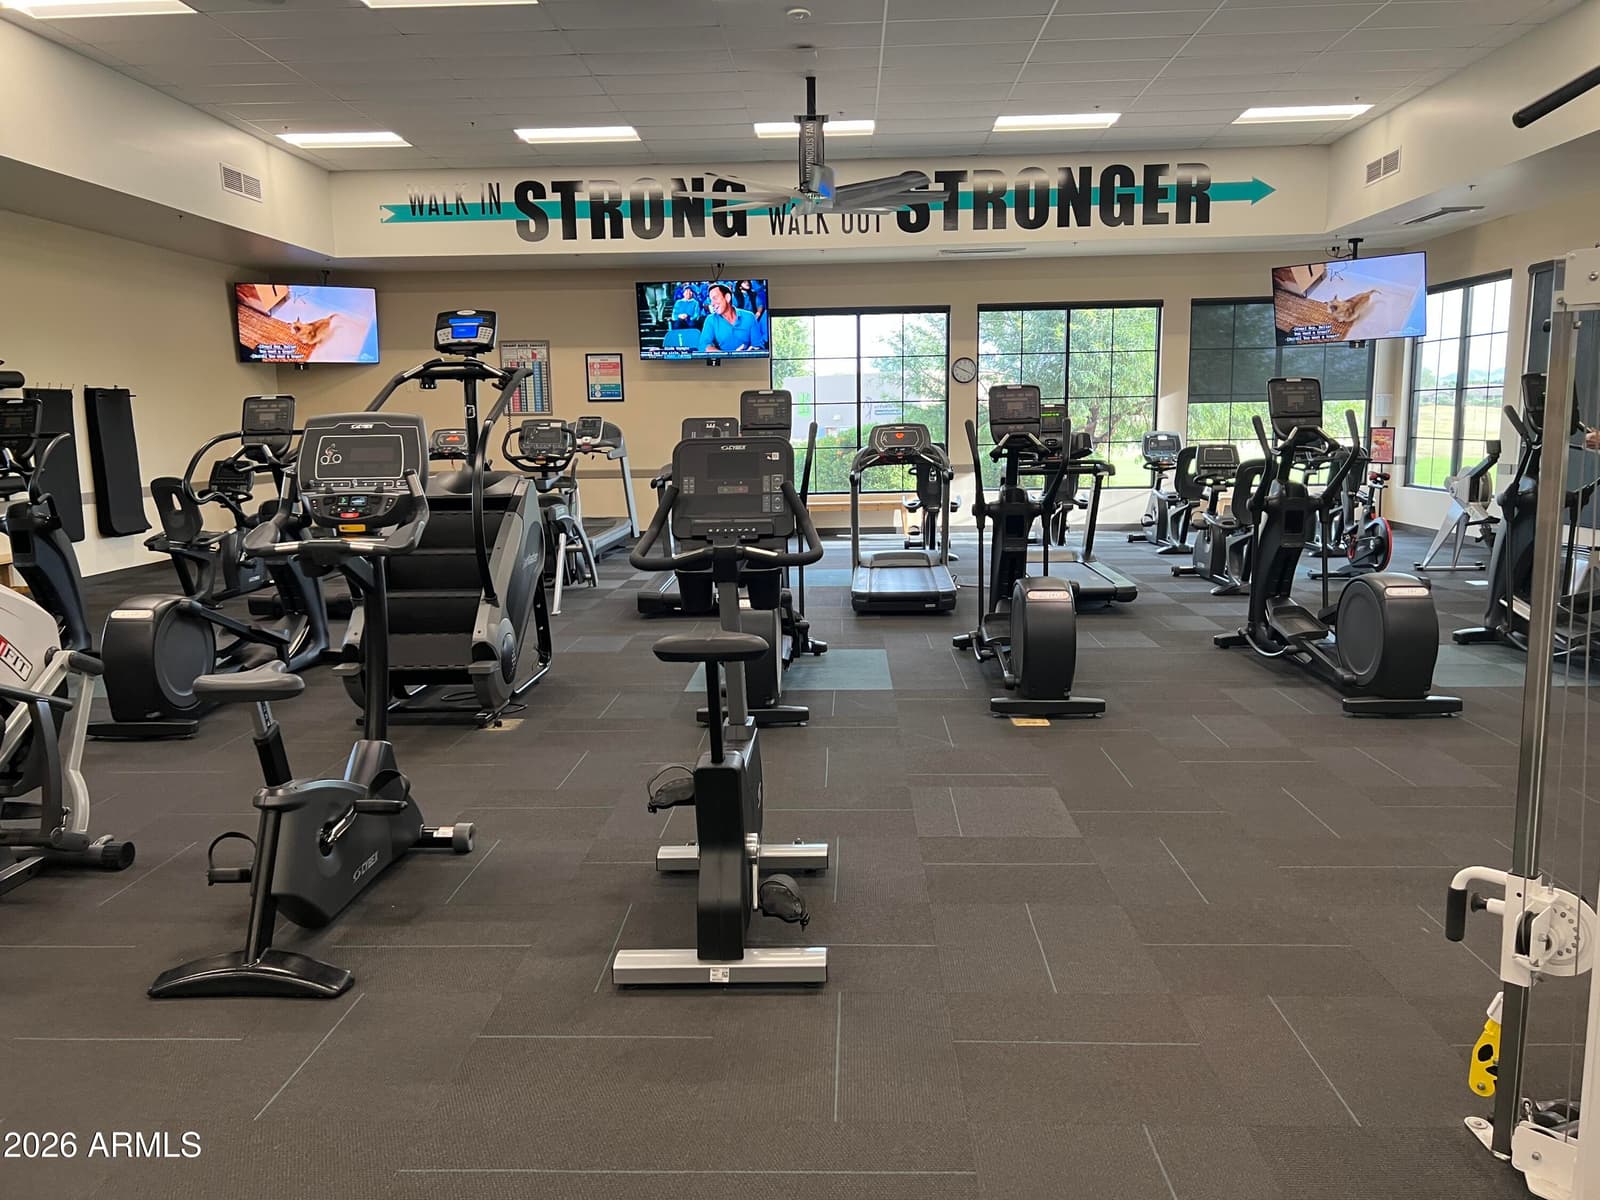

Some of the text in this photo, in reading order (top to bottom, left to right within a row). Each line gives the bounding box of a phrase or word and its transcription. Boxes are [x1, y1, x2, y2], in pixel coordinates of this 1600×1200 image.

[406, 182, 468, 216] WALK
[480, 182, 501, 215] IN
[514, 177, 748, 242] STRONG
[768, 203, 830, 235] WALK
[896, 162, 1212, 234] STRONGER
